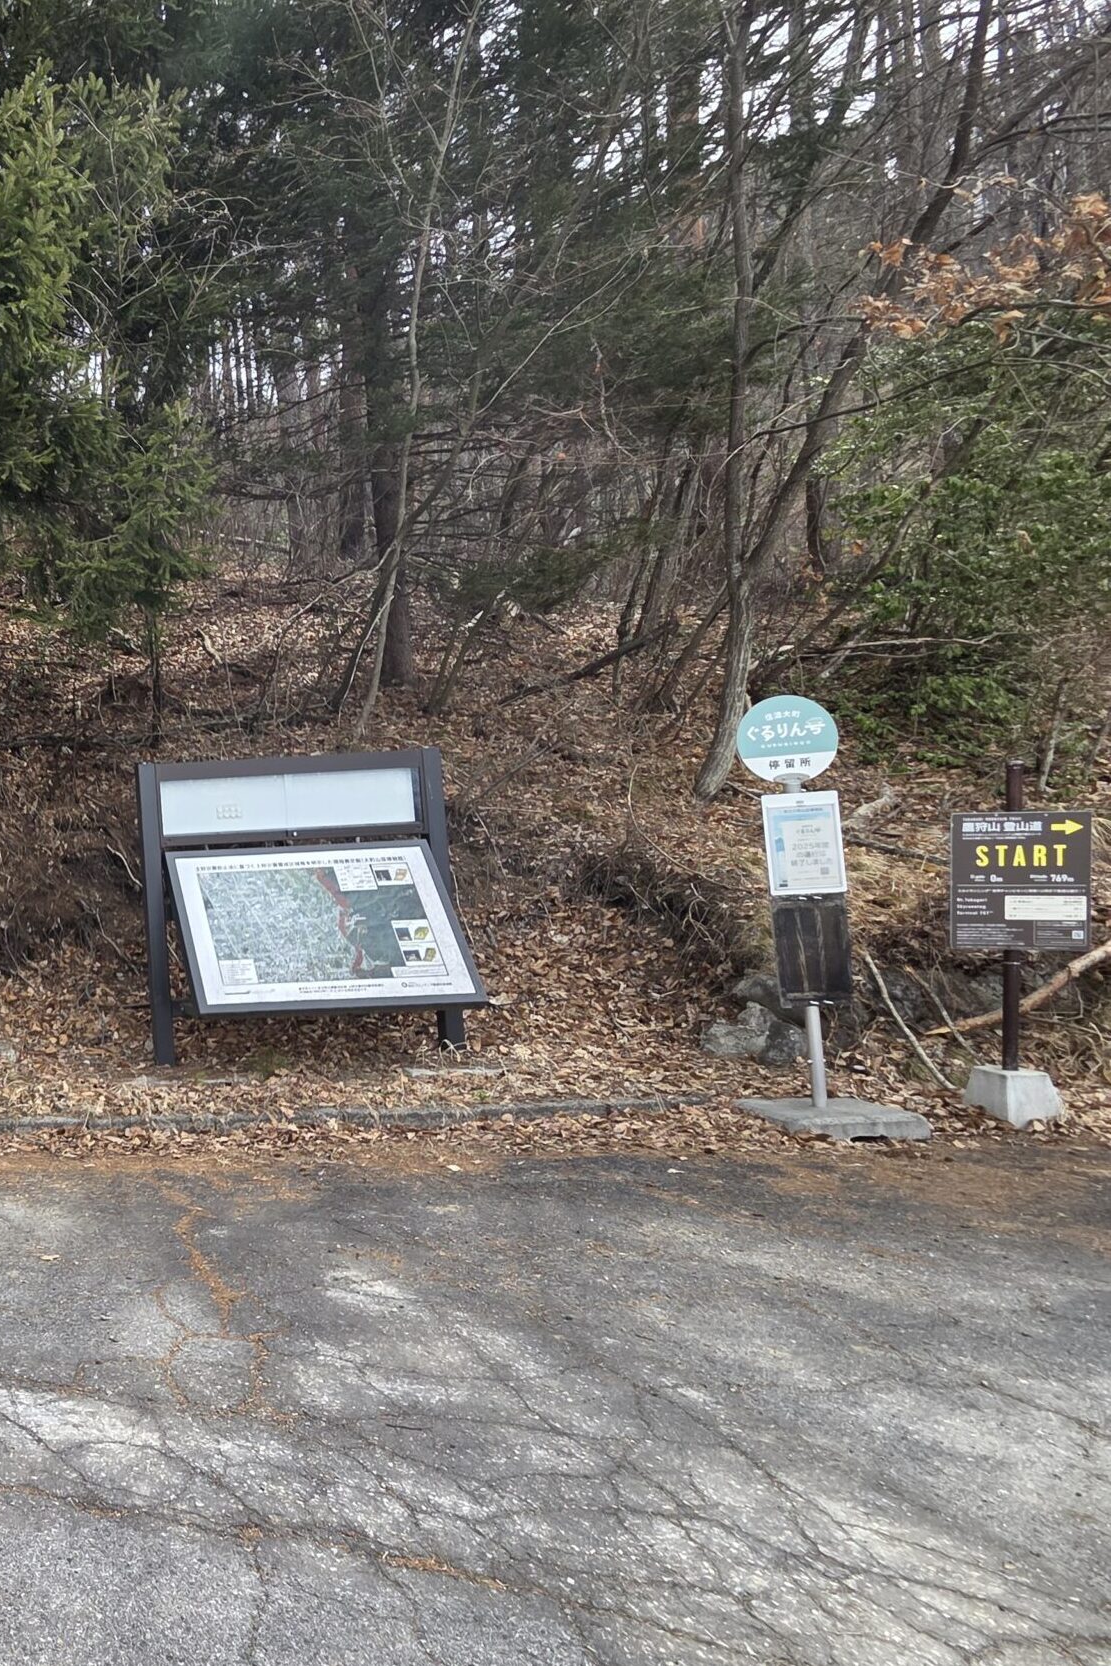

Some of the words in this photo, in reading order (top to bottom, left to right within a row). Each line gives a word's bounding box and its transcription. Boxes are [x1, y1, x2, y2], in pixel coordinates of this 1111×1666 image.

[746, 716, 826, 742] ぐるりん号
[769, 757, 811, 770] 停留所
[1003, 820, 1043, 832] 登山道
[975, 844, 1067, 868] START
[1050, 874, 1075, 882] 769m
